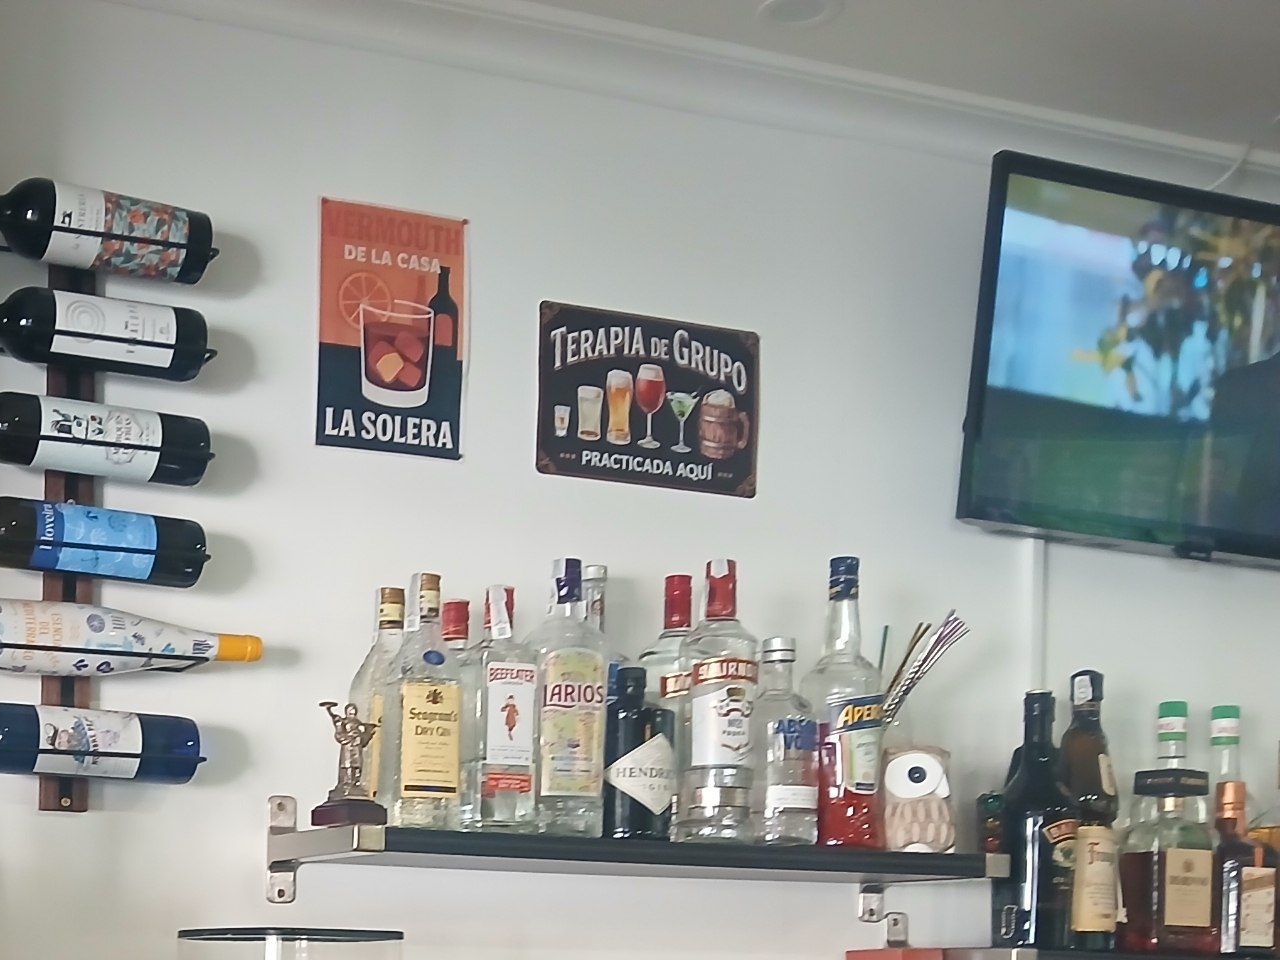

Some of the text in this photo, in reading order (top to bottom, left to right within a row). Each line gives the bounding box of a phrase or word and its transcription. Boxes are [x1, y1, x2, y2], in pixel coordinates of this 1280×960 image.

[326, 206, 461, 256] VERMOUTH
[344, 244, 442, 274] DE LA CASA
[550, 325, 747, 395] TERAPIA DE GRUPO
[325, 406, 453, 448] LA SOLERA
[581, 450, 713, 481] PRACTICADA AQUÍ
[489, 667, 535, 683] BEEFEATER
[543, 684, 604, 709] LARIOS
